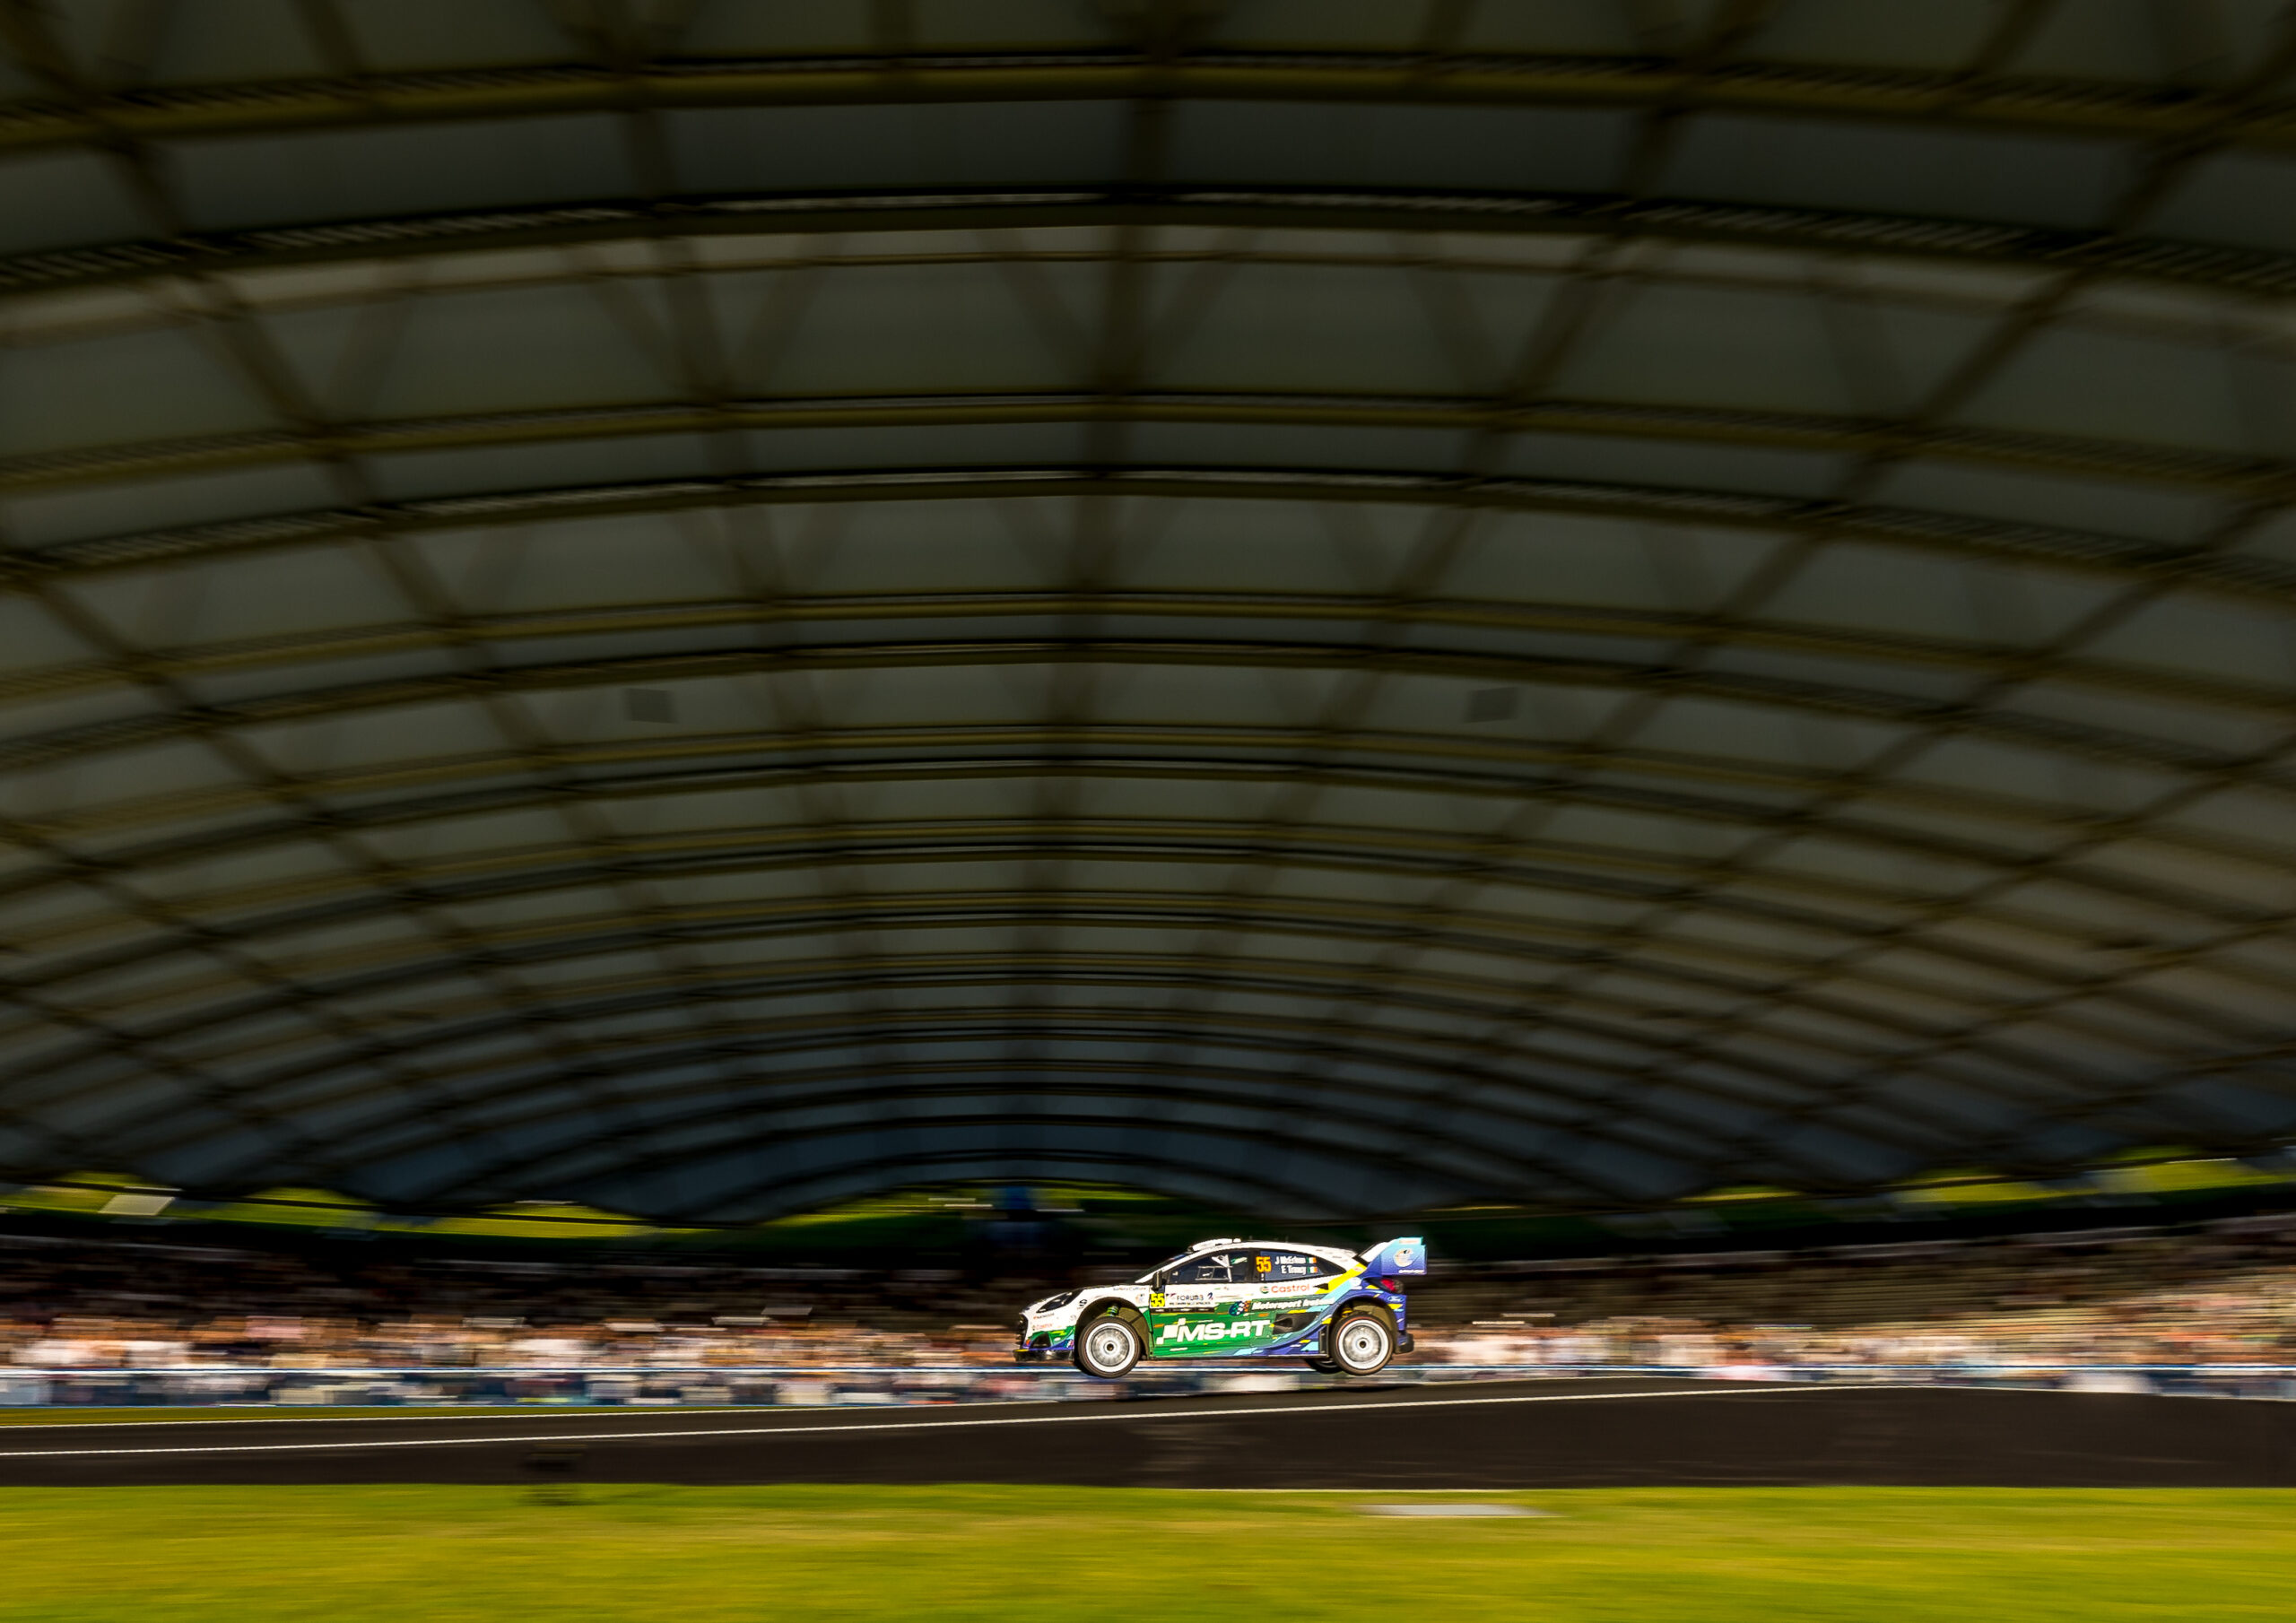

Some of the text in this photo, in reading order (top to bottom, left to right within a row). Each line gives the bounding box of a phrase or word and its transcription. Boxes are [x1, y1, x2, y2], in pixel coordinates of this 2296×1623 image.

[1256, 1256, 1272, 1272] 55
[1274, 1256, 1280, 1264] J
[1281, 1265, 1287, 1273] E
[1271, 1284, 1309, 1293] Castrol
[1150, 1293, 1165, 1307] 55
[1251, 1299, 1302, 1310] Motorsport
[1177, 1320, 1271, 1343] MS-RT
